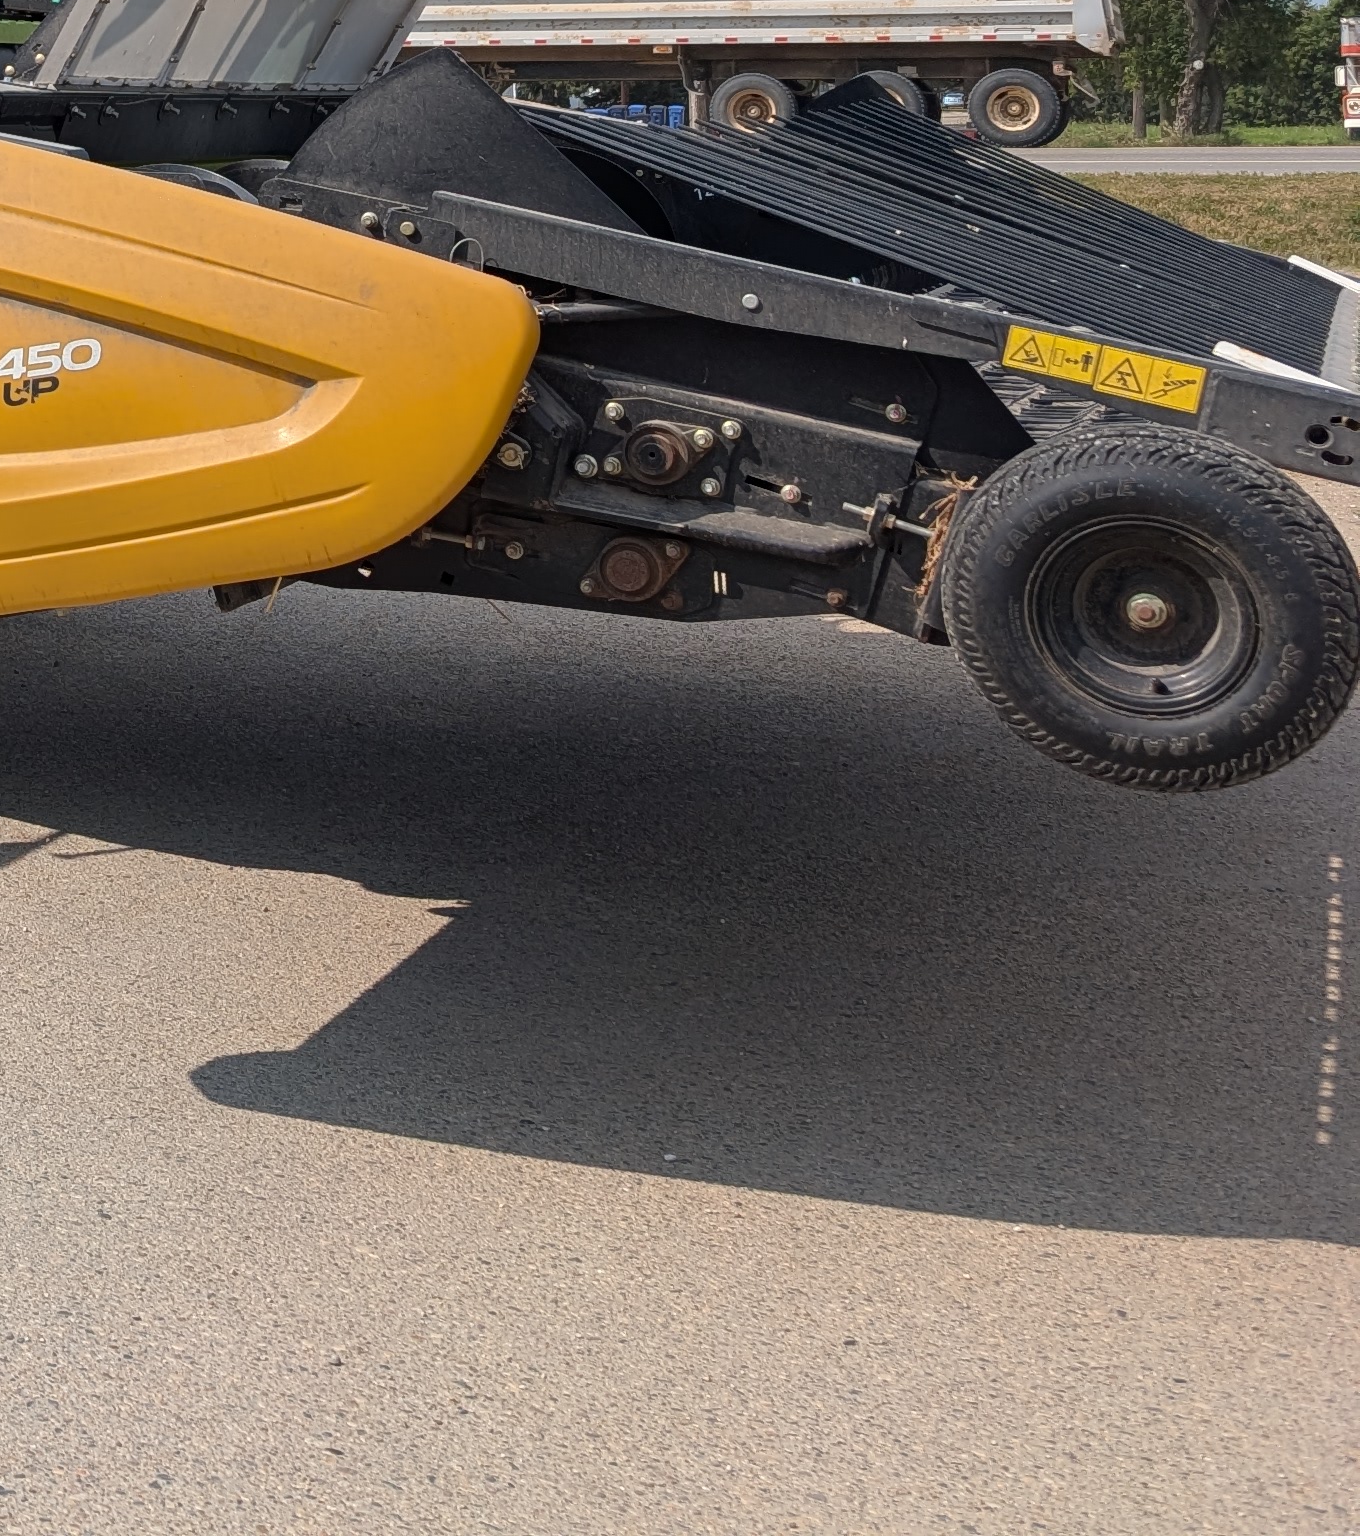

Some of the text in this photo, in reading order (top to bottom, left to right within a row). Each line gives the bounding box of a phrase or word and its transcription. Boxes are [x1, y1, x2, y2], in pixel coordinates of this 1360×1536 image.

[2, 375, 60, 407] UP
[993, 476, 1139, 569] CARLISLE
[1105, 728, 1215, 757] TRAIL
